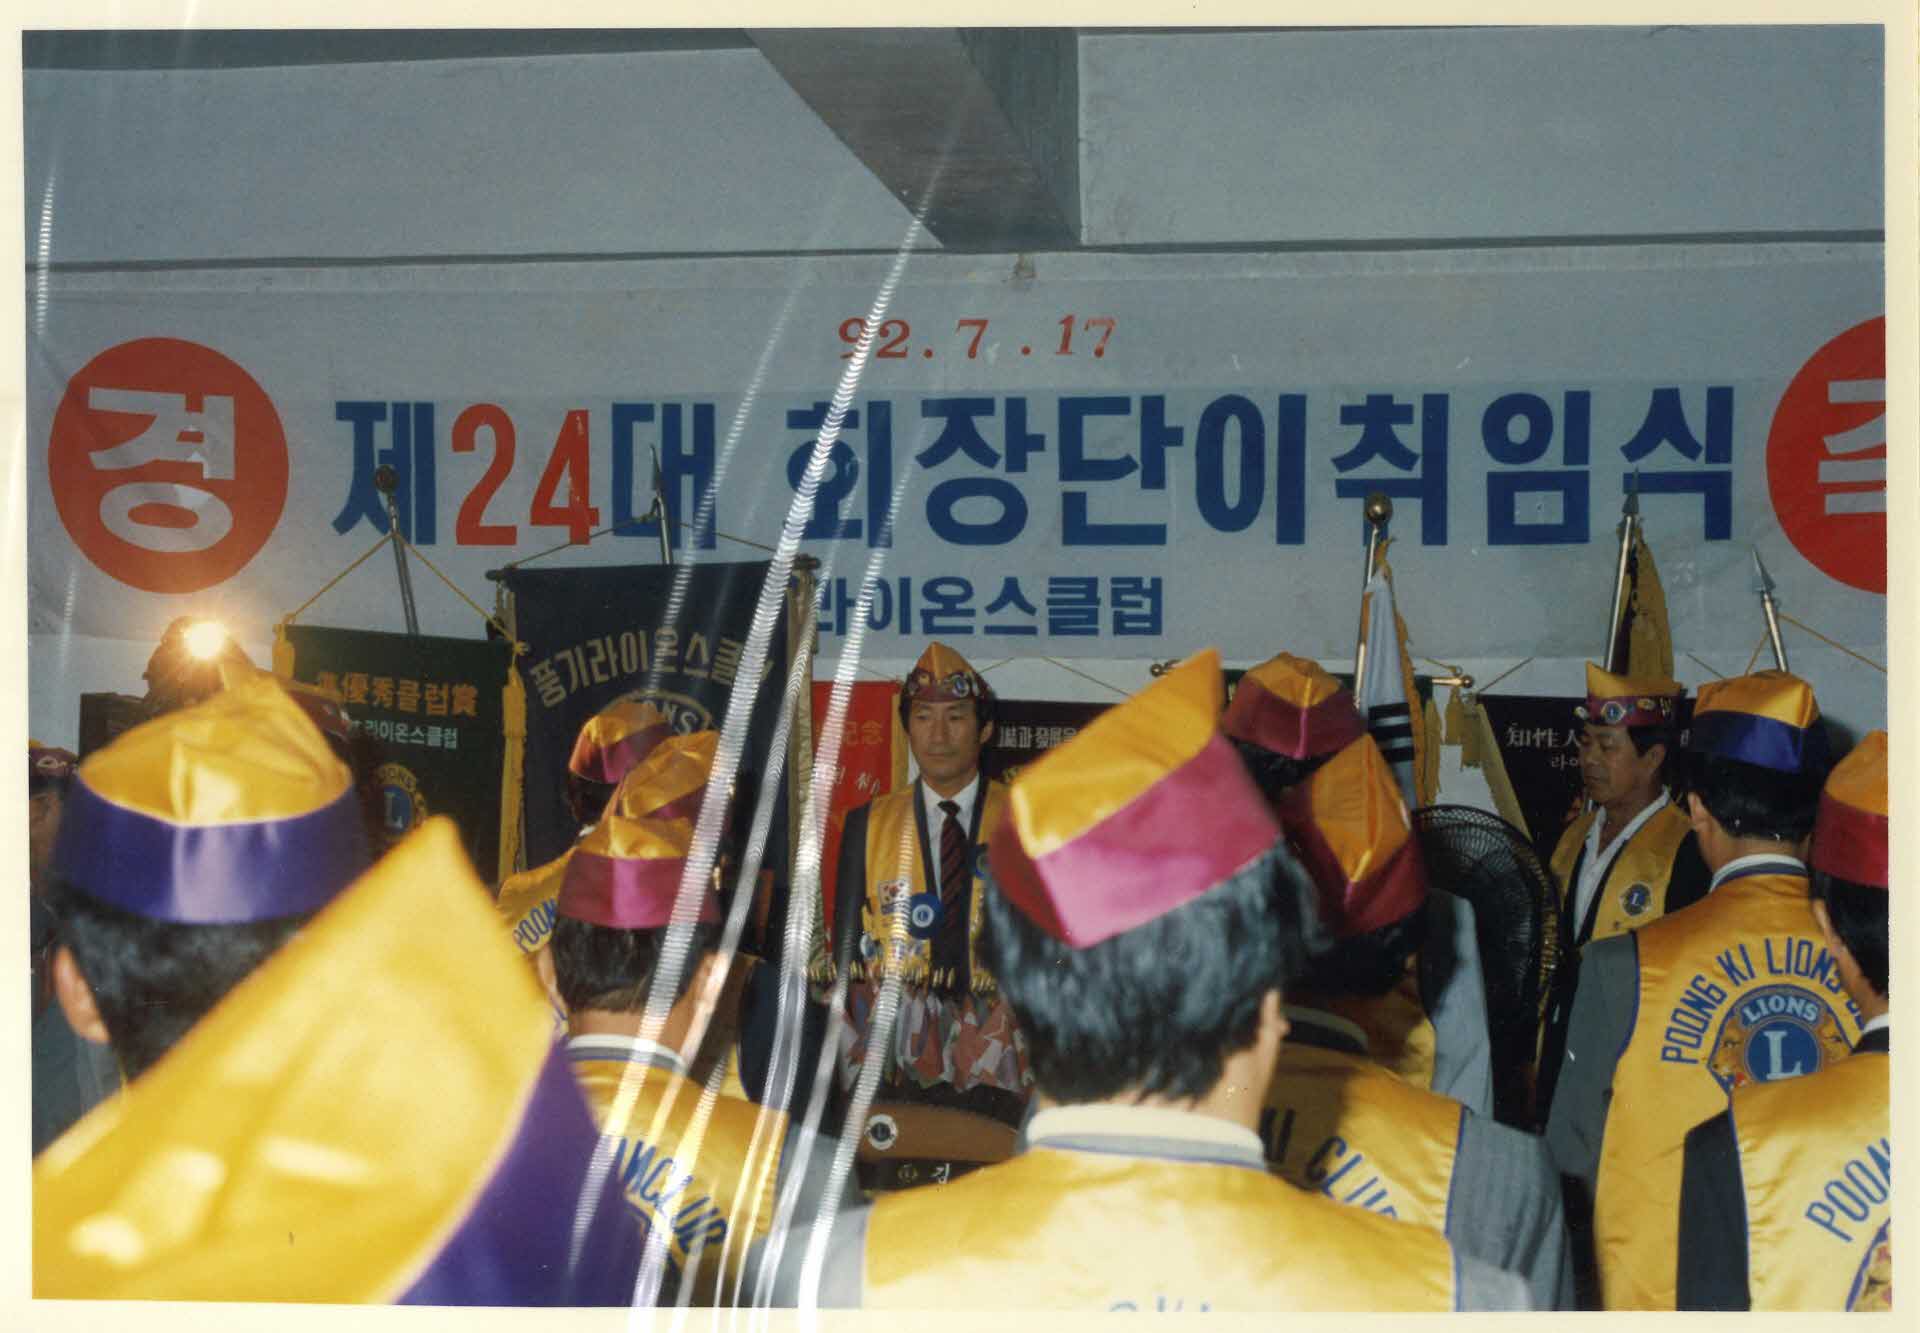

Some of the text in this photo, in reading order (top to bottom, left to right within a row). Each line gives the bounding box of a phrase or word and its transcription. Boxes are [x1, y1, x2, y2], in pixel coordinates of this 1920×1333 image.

[89, 386, 236, 553] 경
[332, 400, 716, 549] 제24대
[530, 627, 774, 708] 풍기라이온스클
[1661, 974, 1728, 1064] POONG
[1716, 943, 1756, 987] KI
[1741, 995, 1819, 1023] LIONS
[1306, 1135, 1397, 1221] CLU
